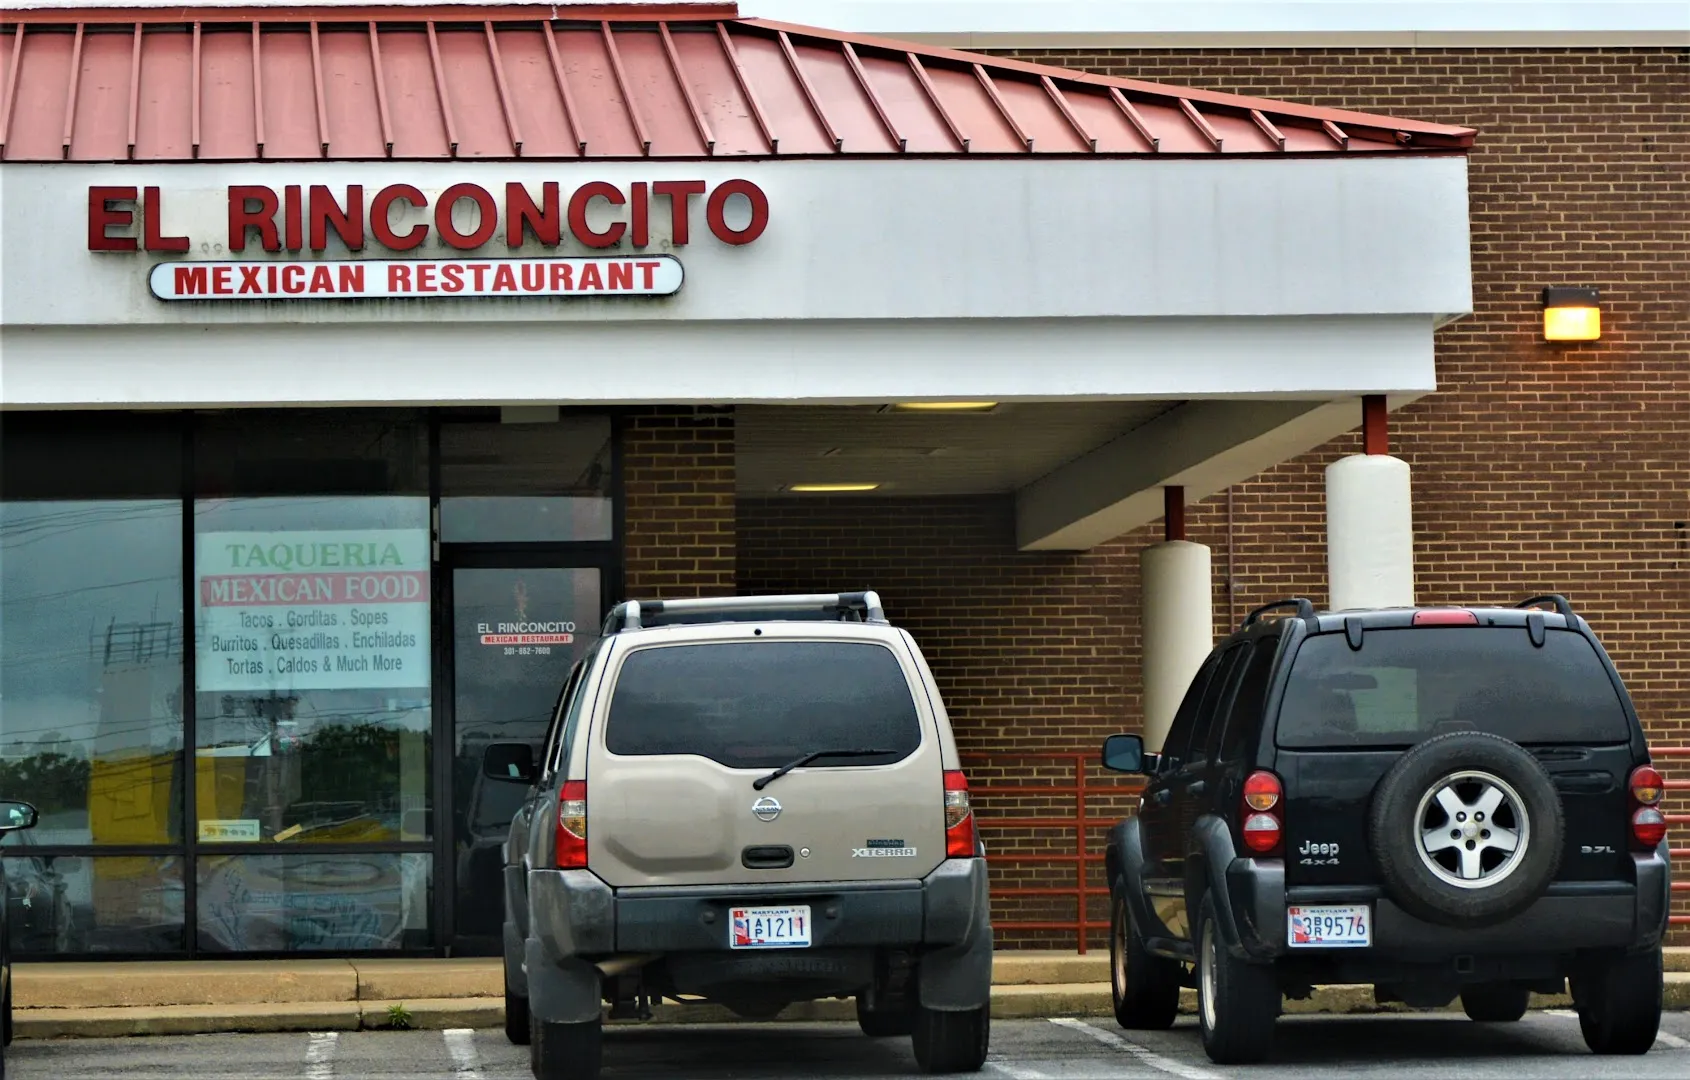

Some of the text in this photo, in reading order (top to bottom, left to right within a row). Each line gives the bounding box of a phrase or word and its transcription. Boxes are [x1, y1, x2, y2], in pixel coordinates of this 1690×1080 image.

[88, 178, 770, 252] EL RINCONCITO
[173, 261, 662, 296] MEXICAN RESTAURANT
[226, 542, 404, 571] TAQUERIA
[210, 574, 421, 602] MEXICAN FOOD
[239, 608, 389, 629] Tacos Gorditas Sopes
[477, 621, 576, 633] EL RINCONCITO
[212, 631, 416, 652] Burritos Quesadillas Enchiladas
[484, 634, 569, 643] MEXICAN RESTAURANT
[226, 654, 403, 675] Tortas Caldos & Much More
[1299, 840, 1340, 856] Jeep
